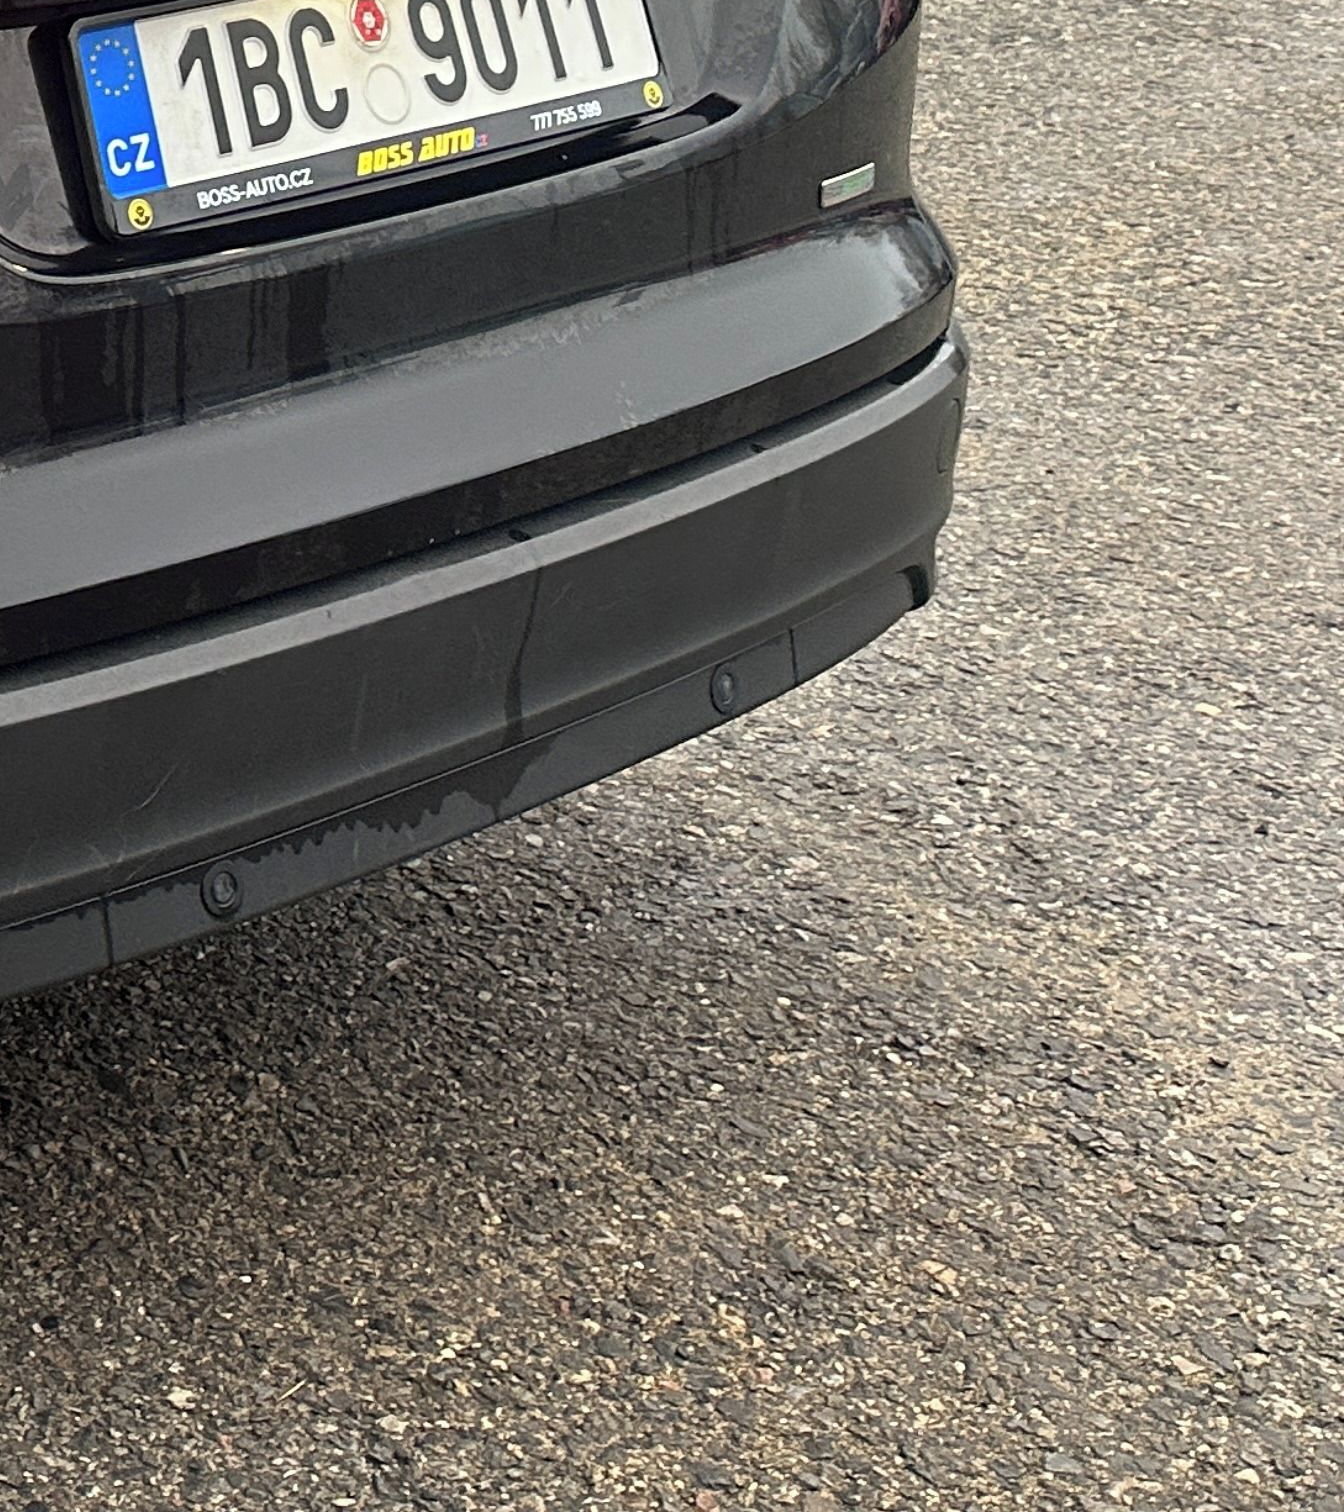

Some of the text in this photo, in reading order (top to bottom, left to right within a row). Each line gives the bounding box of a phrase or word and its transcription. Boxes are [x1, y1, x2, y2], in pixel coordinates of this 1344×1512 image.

[178, 7, 349, 155] 1BC
[106, 133, 156, 177] CZ
[356, 141, 414, 177] BOSS
[196, 167, 314, 210] BOSS-AUTO.CZ
